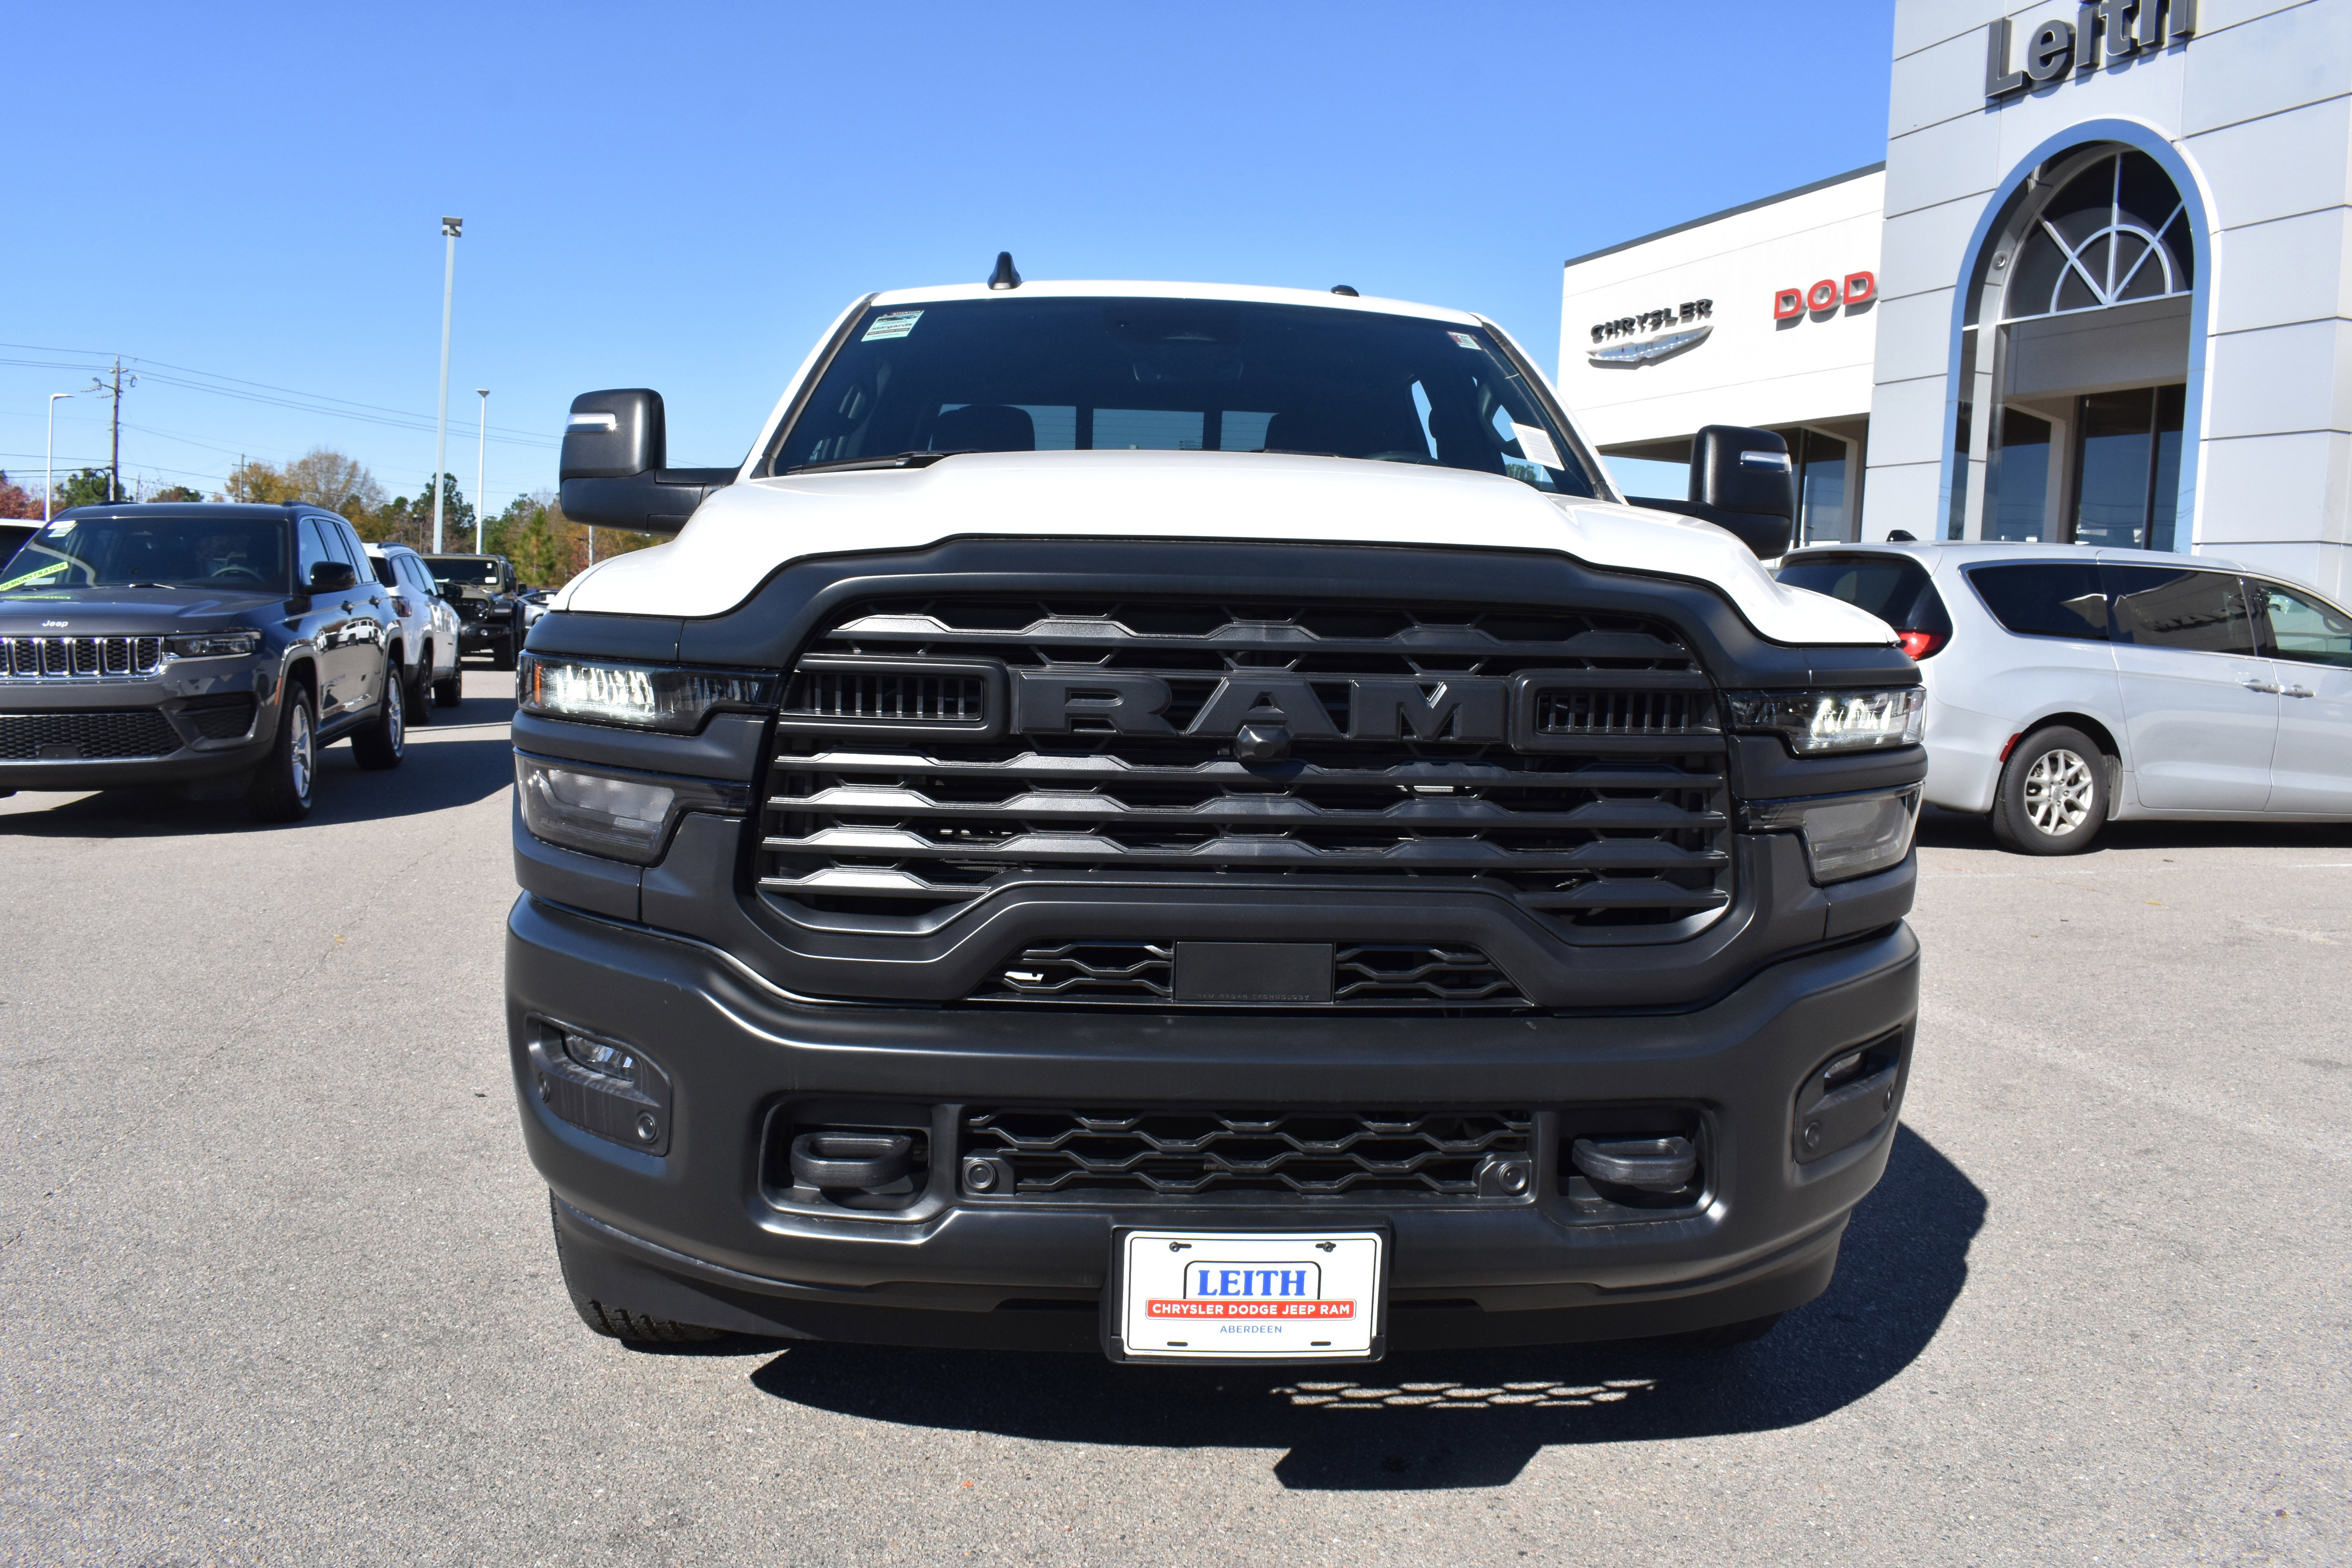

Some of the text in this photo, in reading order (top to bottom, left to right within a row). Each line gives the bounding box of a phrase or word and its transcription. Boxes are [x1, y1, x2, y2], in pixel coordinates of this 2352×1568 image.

[1590, 298, 1713, 341] CHRYSLER
[0, 563, 65, 590] DEMONSTRATOR
[1018, 671, 1509, 744] RAM
[1197, 1270, 1307, 1296] LEITH
[1152, 1303, 1350, 1315] CHRYSLER DODGE JEEP RAM
[1220, 1325, 1282, 1334] ABERDEEN
